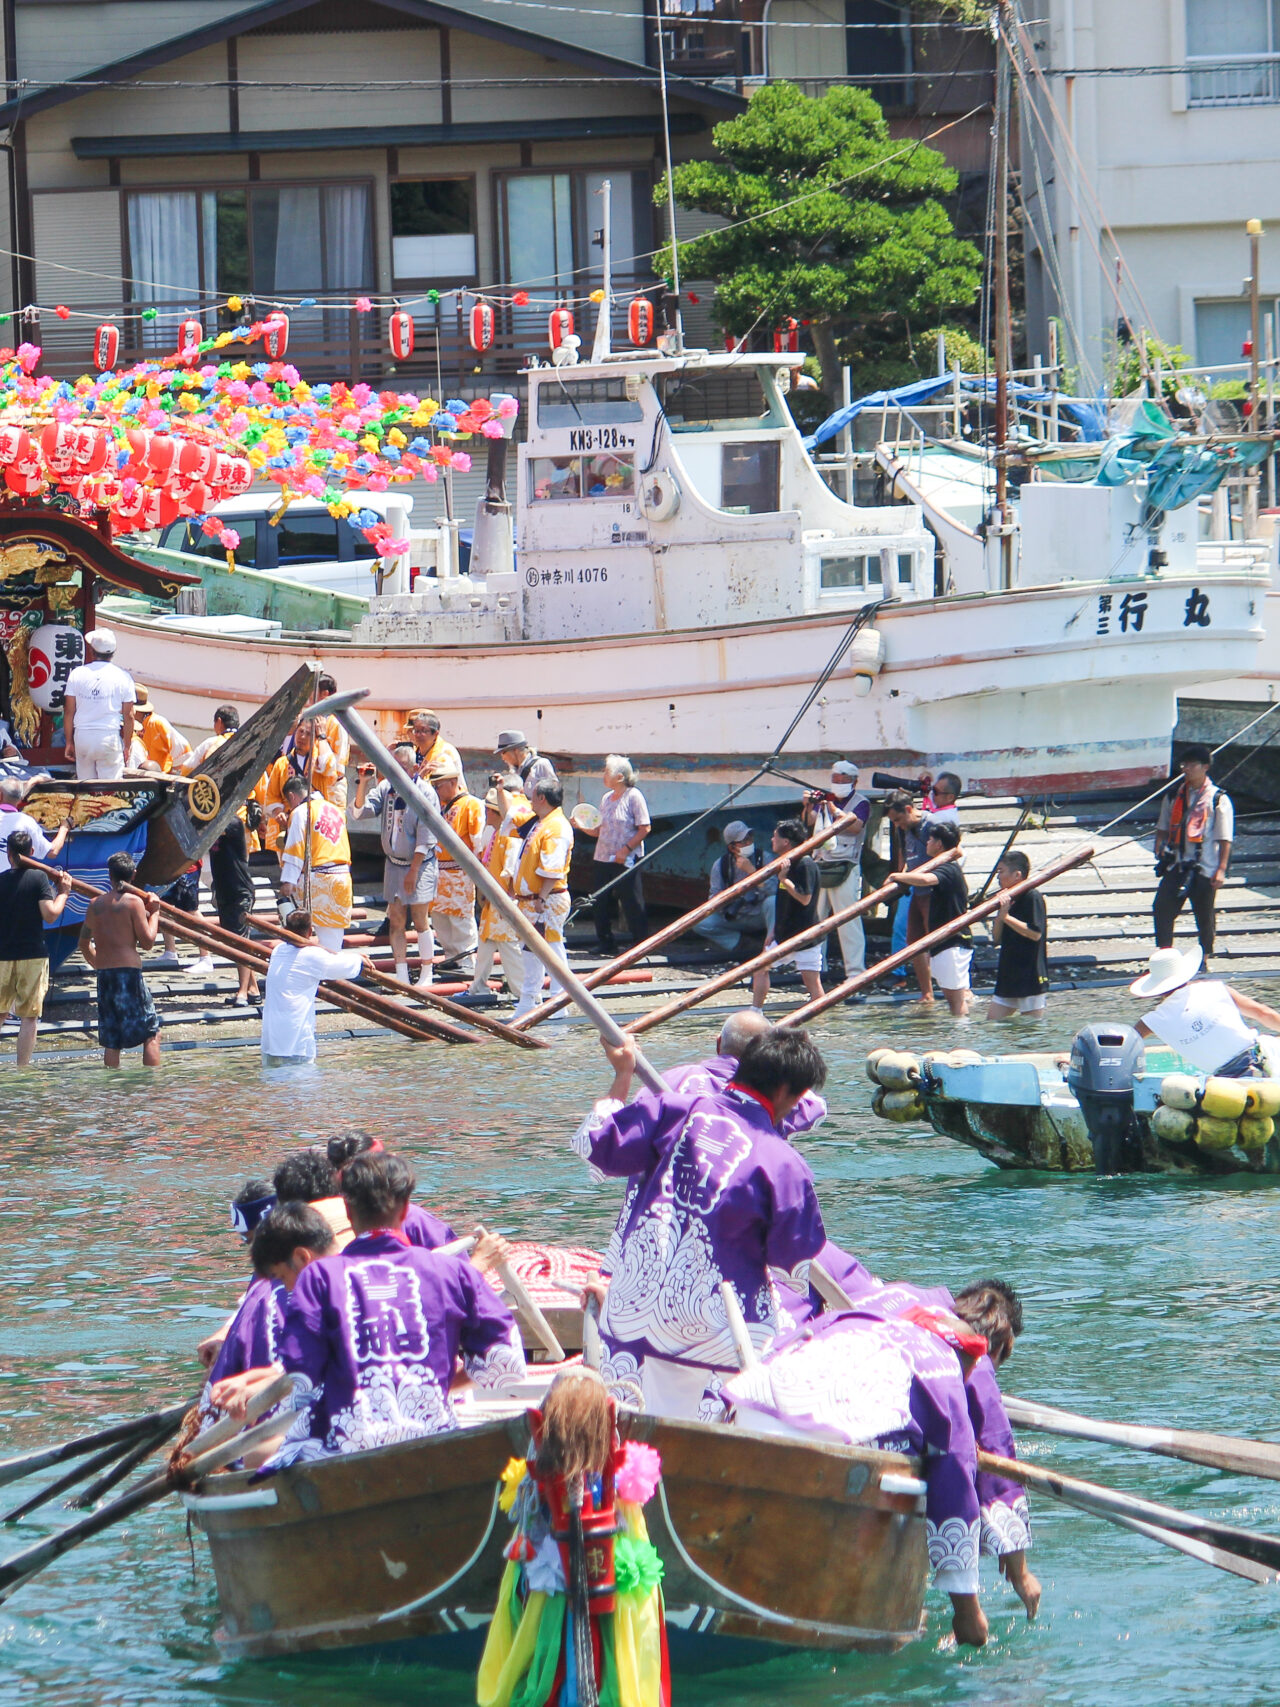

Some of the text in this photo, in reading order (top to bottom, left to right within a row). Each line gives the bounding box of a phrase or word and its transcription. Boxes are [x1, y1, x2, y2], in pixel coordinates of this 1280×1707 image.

[60, 430, 77, 450] 東
[76, 433, 91, 453] 東
[217, 463, 233, 480] 東
[231, 464, 249, 485] 東
[195, 782, 213, 812] 東
[1099, 1057, 1122, 1067] 25
